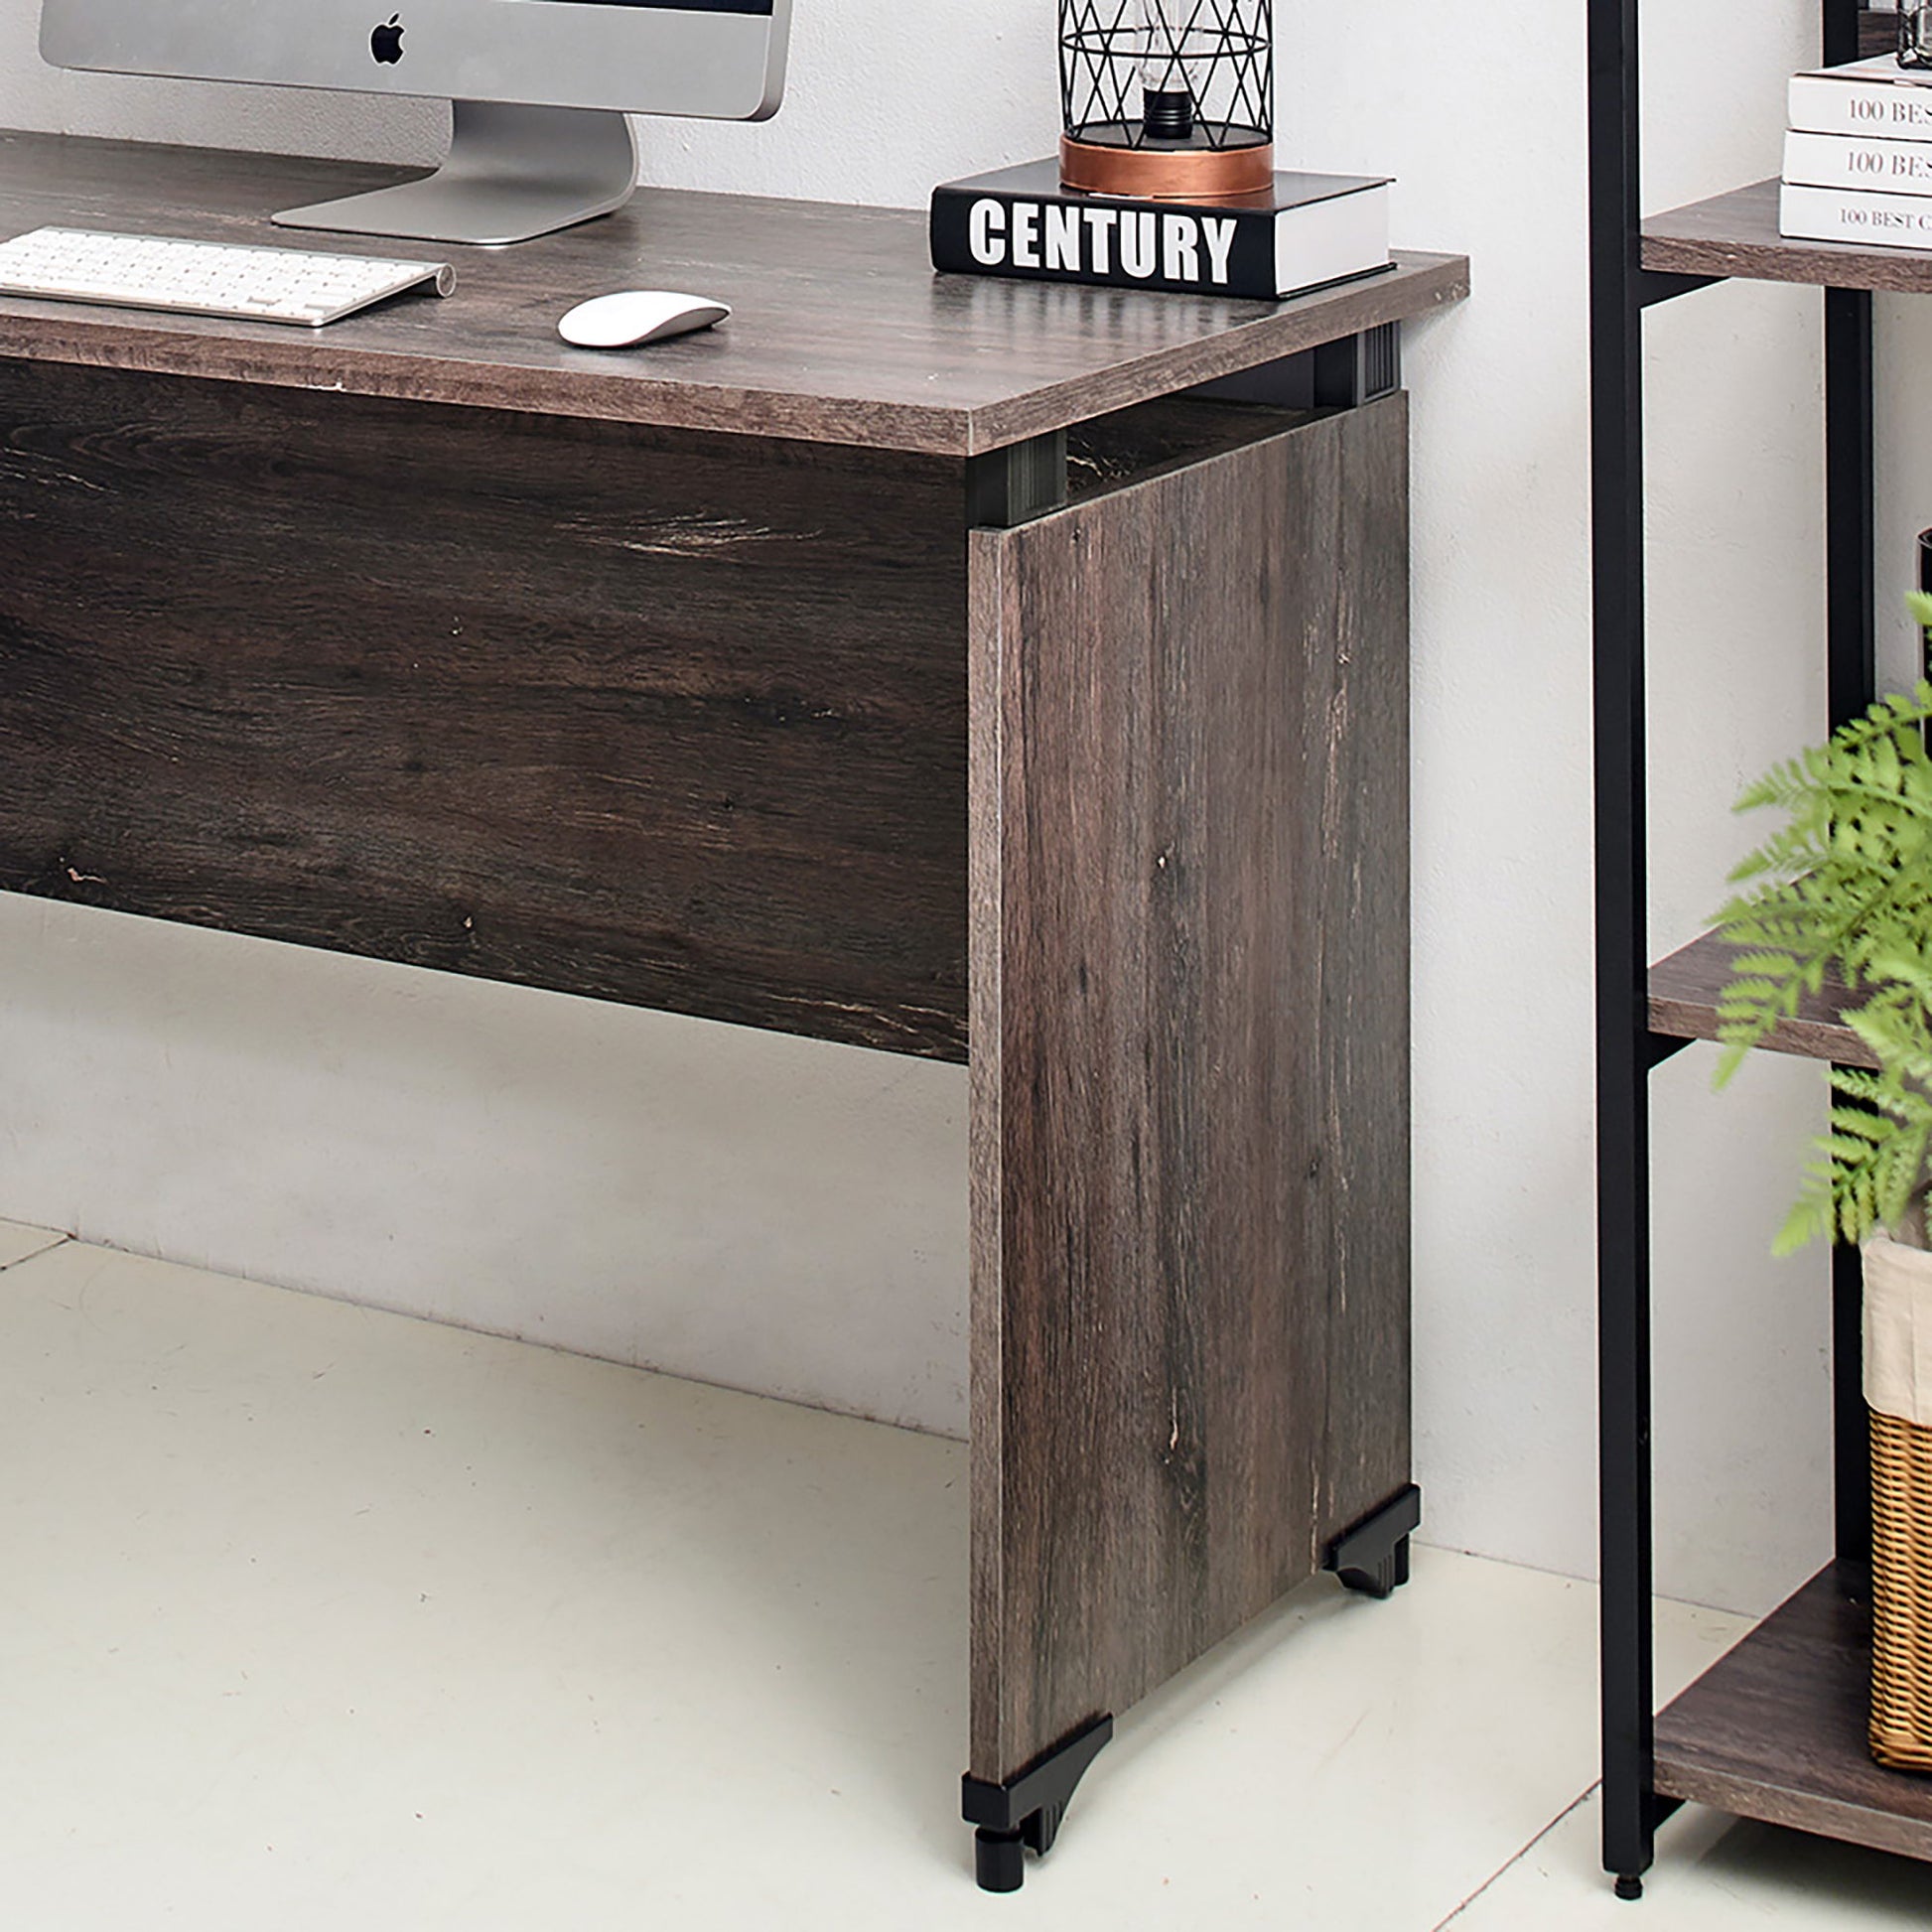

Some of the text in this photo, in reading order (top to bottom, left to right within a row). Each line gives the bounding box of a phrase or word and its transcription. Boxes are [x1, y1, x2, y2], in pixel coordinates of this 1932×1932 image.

[1850, 98, 1884, 120] 100
[1848, 151, 1883, 174] 100
[1841, 207, 1867, 224] 100
[1871, 210, 1914, 228] BEST
[969, 199, 1237, 284] CENTURY
